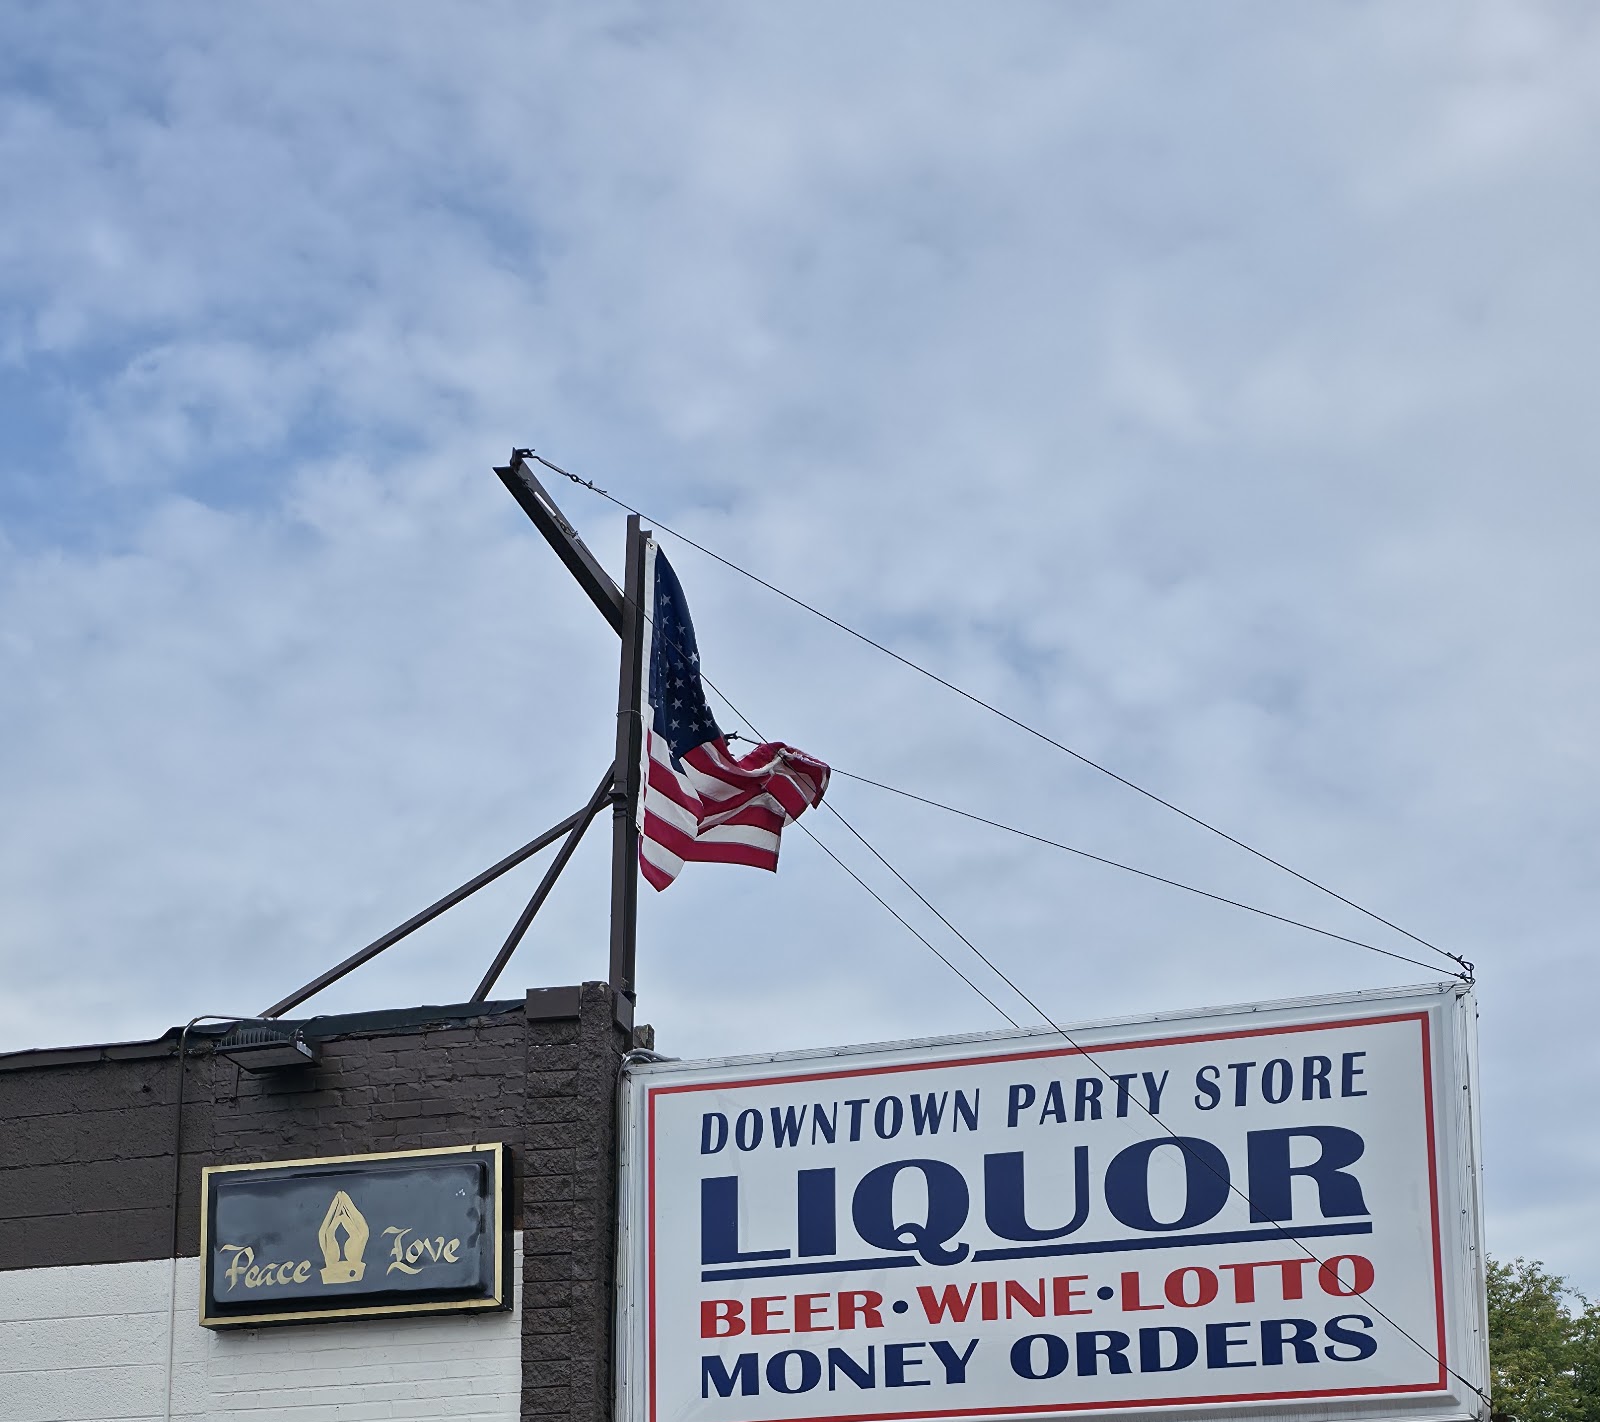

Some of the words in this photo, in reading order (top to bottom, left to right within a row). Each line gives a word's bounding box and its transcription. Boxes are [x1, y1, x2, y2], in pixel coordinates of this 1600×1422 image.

[701, 1088, 980, 1155] DOWNTOWN
[1007, 1070, 1169, 1128] PARTY
[1194, 1051, 1368, 1111] STORE
[701, 1124, 1371, 1267] LIQUOR
[219, 1244, 312, 1292] Peace
[380, 1226, 461, 1276] Love
[701, 1338, 980, 1399] MONEY
[1010, 1314, 1378, 1380] ORDERS
